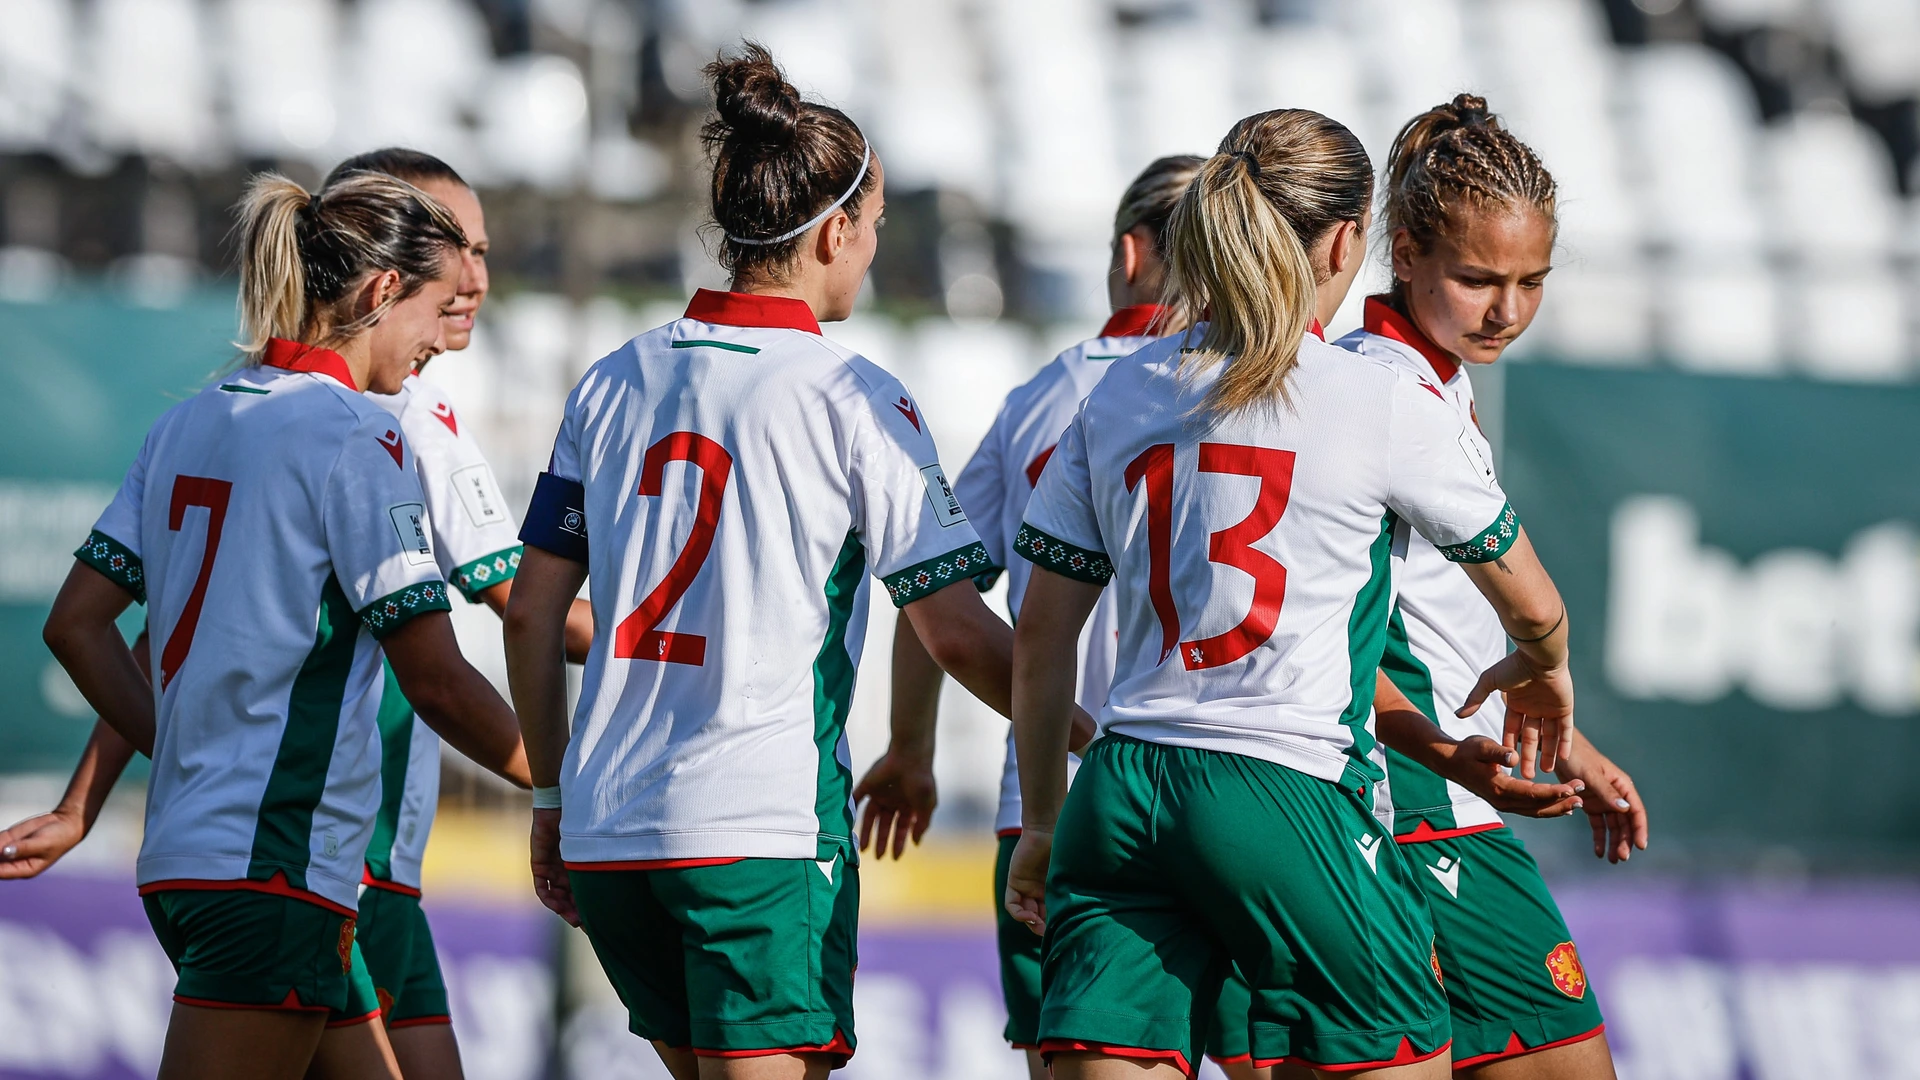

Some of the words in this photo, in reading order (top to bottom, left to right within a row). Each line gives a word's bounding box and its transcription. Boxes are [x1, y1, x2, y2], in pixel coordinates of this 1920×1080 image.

[161, 474, 233, 694] 7
[613, 430, 734, 667] 2
[1123, 442, 1297, 672] 13
